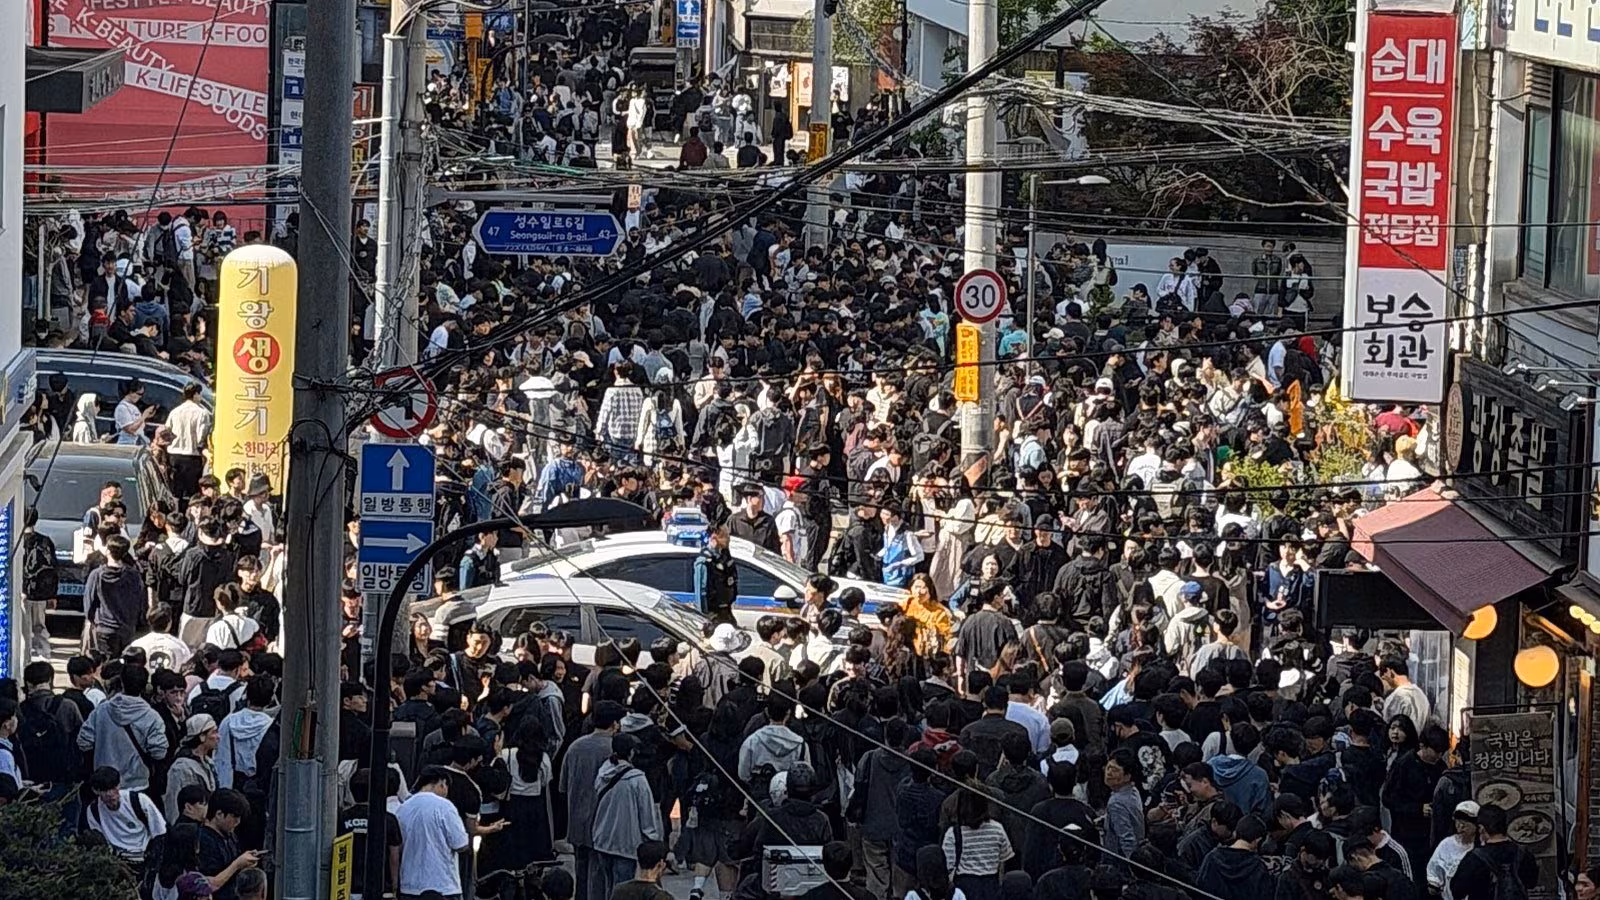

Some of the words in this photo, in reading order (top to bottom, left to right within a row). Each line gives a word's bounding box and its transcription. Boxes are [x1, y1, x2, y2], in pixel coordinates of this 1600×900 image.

[76, 7, 174, 72] K-BEAUTY
[1371, 38, 1446, 84] 순대
[135, 68, 266, 113] K-LIFESTYLE
[1368, 105, 1442, 154] 수육
[1364, 161, 1442, 206] 국밥
[487, 226, 500, 236] 47
[514, 214, 585, 230] 성수일로6길
[598, 229, 610, 240] 43
[1363, 213, 1440, 246] 전문점
[965, 284, 996, 309] 30
[1364, 292, 1434, 332] 보승
[235, 266, 273, 436] 기왕생고기
[1363, 331, 1434, 368] 회관
[363, 497, 431, 513] 일방통행
[1486, 730, 1535, 748] 국밥은
